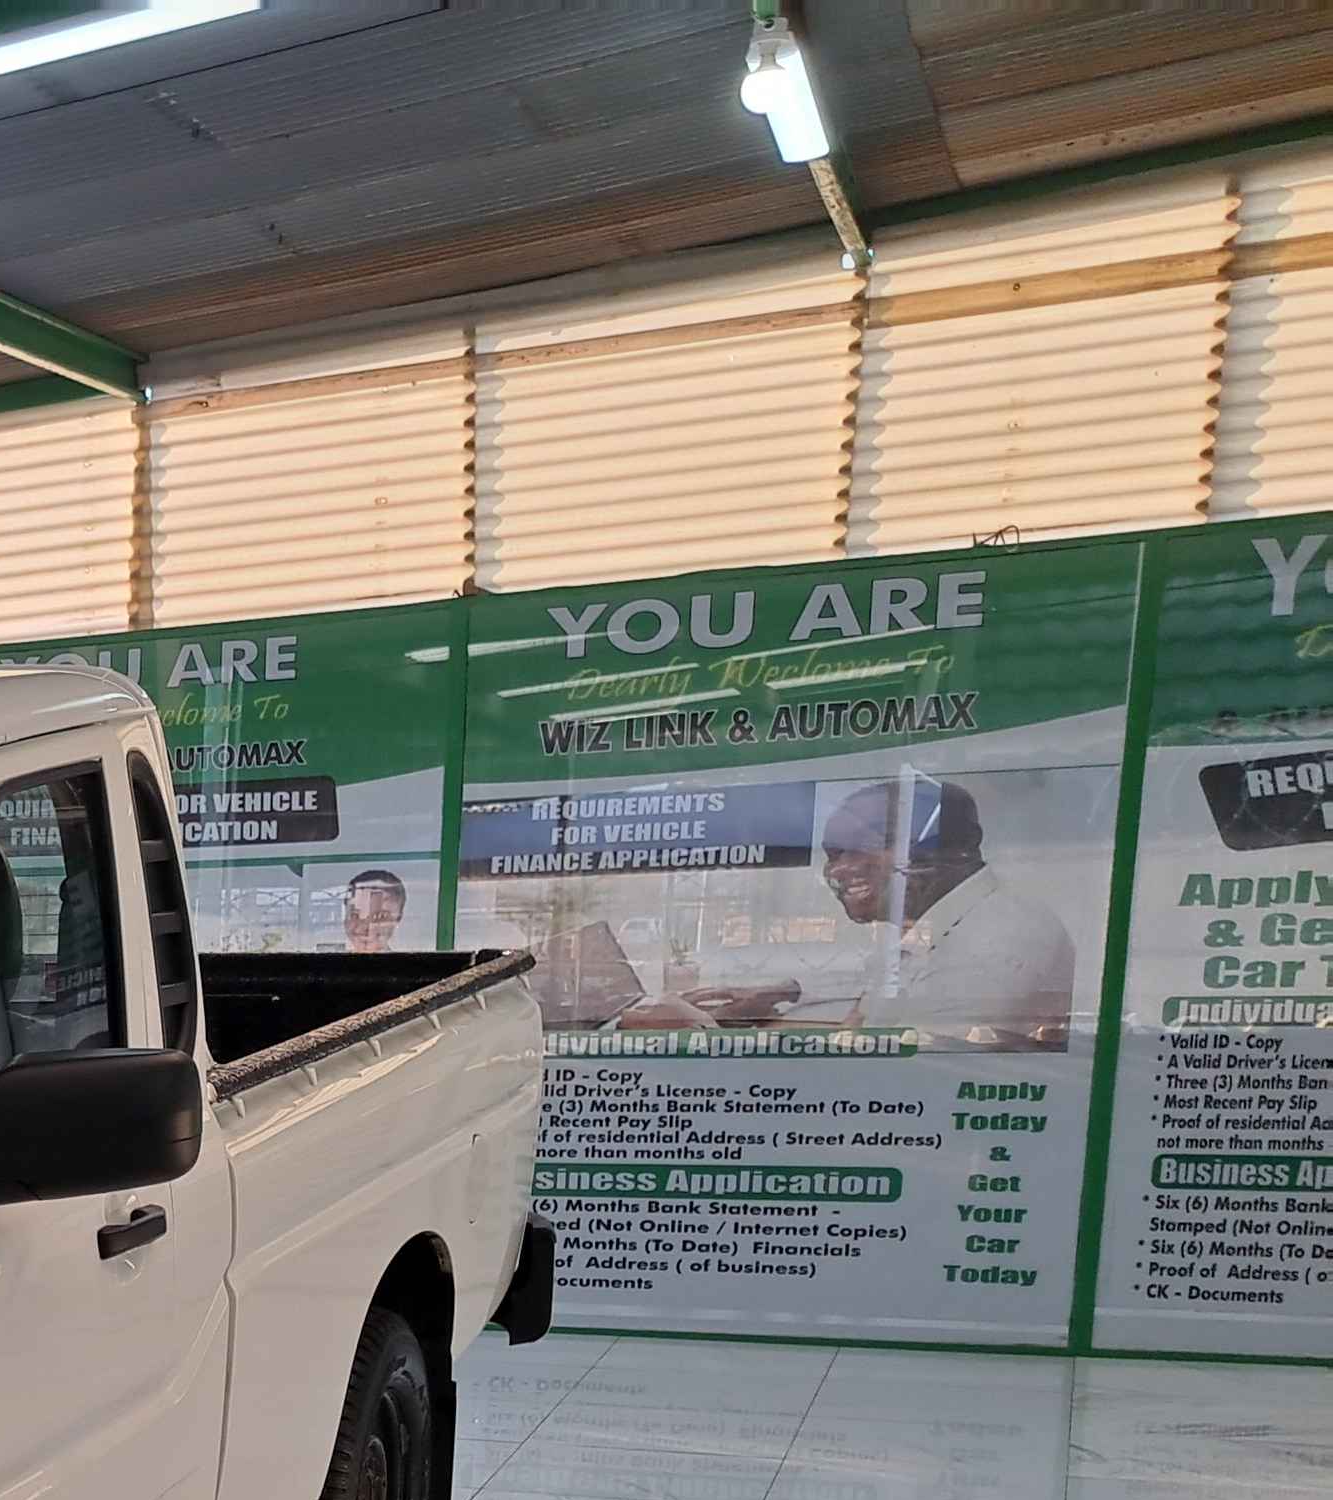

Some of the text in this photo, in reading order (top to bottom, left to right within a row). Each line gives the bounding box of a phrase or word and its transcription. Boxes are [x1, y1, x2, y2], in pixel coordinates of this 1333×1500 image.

[547, 570, 986, 660] YOU ARE
[167, 636, 297, 688] ARE
[253, 694, 289, 721] To
[540, 691, 980, 756] WIZ LINK & AUTOMAX
[177, 790, 317, 815] OR VEHICLE
[533, 793, 724, 820] REQUIREMENTS
[184, 821, 278, 842] CATION
[551, 820, 707, 846] FOR VEHICLE
[491, 845, 765, 874] FINANCE APPLICATION
[1204, 920, 1244, 947] &
[1203, 956, 1305, 988] Car
[543, 1031, 901, 1056] dividual Application
[1171, 1035, 1208, 1048] Valid
[1213, 1035, 1229, 1048] ID
[1246, 1035, 1283, 1052] Copy
[1167, 1055, 1178, 1068] A
[1185, 1055, 1221, 1068] Valid
[1227, 1055, 1286, 1069] Driver's
[556, 1070, 574, 1081] ID
[597, 1070, 642, 1085] Copy
[1167, 1075, 1207, 1089] Three
[1213, 1075, 1232, 1092] (3)
[1237, 1075, 1292, 1089] Months
[574, 1085, 649, 1097] Driver's
[657, 1085, 726, 1097] License
[749, 1085, 797, 1100] Copy
[957, 1081, 1047, 1101] Apply
[559, 1100, 583, 1115] (3)
[591, 1100, 659, 1113] Months
[668, 1101, 716, 1112] Bank
[725, 1101, 824, 1113] Statement
[833, 1101, 860, 1116] (To
[869, 1101, 923, 1117] Date)
[1163, 1095, 1317, 1113] Most Recent Pay Slip
[550, 1116, 610, 1128] Recent
[618, 1116, 650, 1131] Pay
[658, 1115, 692, 1131] Slip
[952, 1112, 1047, 1133] Today
[1162, 1114, 1201, 1128] Proof
[1206, 1114, 1221, 1129] of
[1225, 1115, 1306, 1130] residential
[554, 1131, 572, 1143] of
[578, 1130, 679, 1144] residential
[687, 1132, 765, 1144] Address
[786, 1132, 844, 1145] Street
[852, 1133, 942, 1149] Address)
[1157, 1135, 1324, 1150] not more than months
[584, 1146, 627, 1158] than
[634, 1147, 704, 1159] months
[712, 1147, 741, 1160] old
[989, 1147, 1011, 1161] &
[1159, 1158, 1290, 1186] Business
[535, 1168, 890, 1196] siness Application
[968, 1174, 1021, 1192] Get
[566, 1200, 640, 1213] Months
[648, 1201, 701, 1214] Bank
[709, 1202, 818, 1216] Statement
[957, 1204, 1027, 1223] Your
[1155, 1195, 1180, 1209] Six
[1185, 1196, 1208, 1213] (6)
[1214, 1197, 1278, 1212] Months
[588, 1219, 632, 1233] (Not
[640, 1220, 709, 1234] Online
[734, 1221, 818, 1237] Internet
[827, 1225, 907, 1240] Copies)
[1149, 1217, 1226, 1236] Stamped
[1233, 1220, 1271, 1236] (Not
[564, 1238, 861, 1257] Months (To Date) Financials
[965, 1235, 1020, 1253] Car
[1150, 1240, 1175, 1254] Six
[1181, 1241, 1203, 1258] (6)
[1209, 1241, 1273, 1257] Months
[1280, 1243, 1305, 1261] (To
[586, 1257, 668, 1271] Address
[690, 1260, 710, 1272] of
[718, 1260, 816, 1278] business)
[943, 1265, 1037, 1286] Today
[1149, 1262, 1195, 1277] Proof
[1200, 1263, 1217, 1278] of
[1228, 1265, 1299, 1281] Address
[557, 1277, 653, 1289] ocuments
[1147, 1284, 1169, 1299] CK
[1188, 1285, 1283, 1304] Documents
